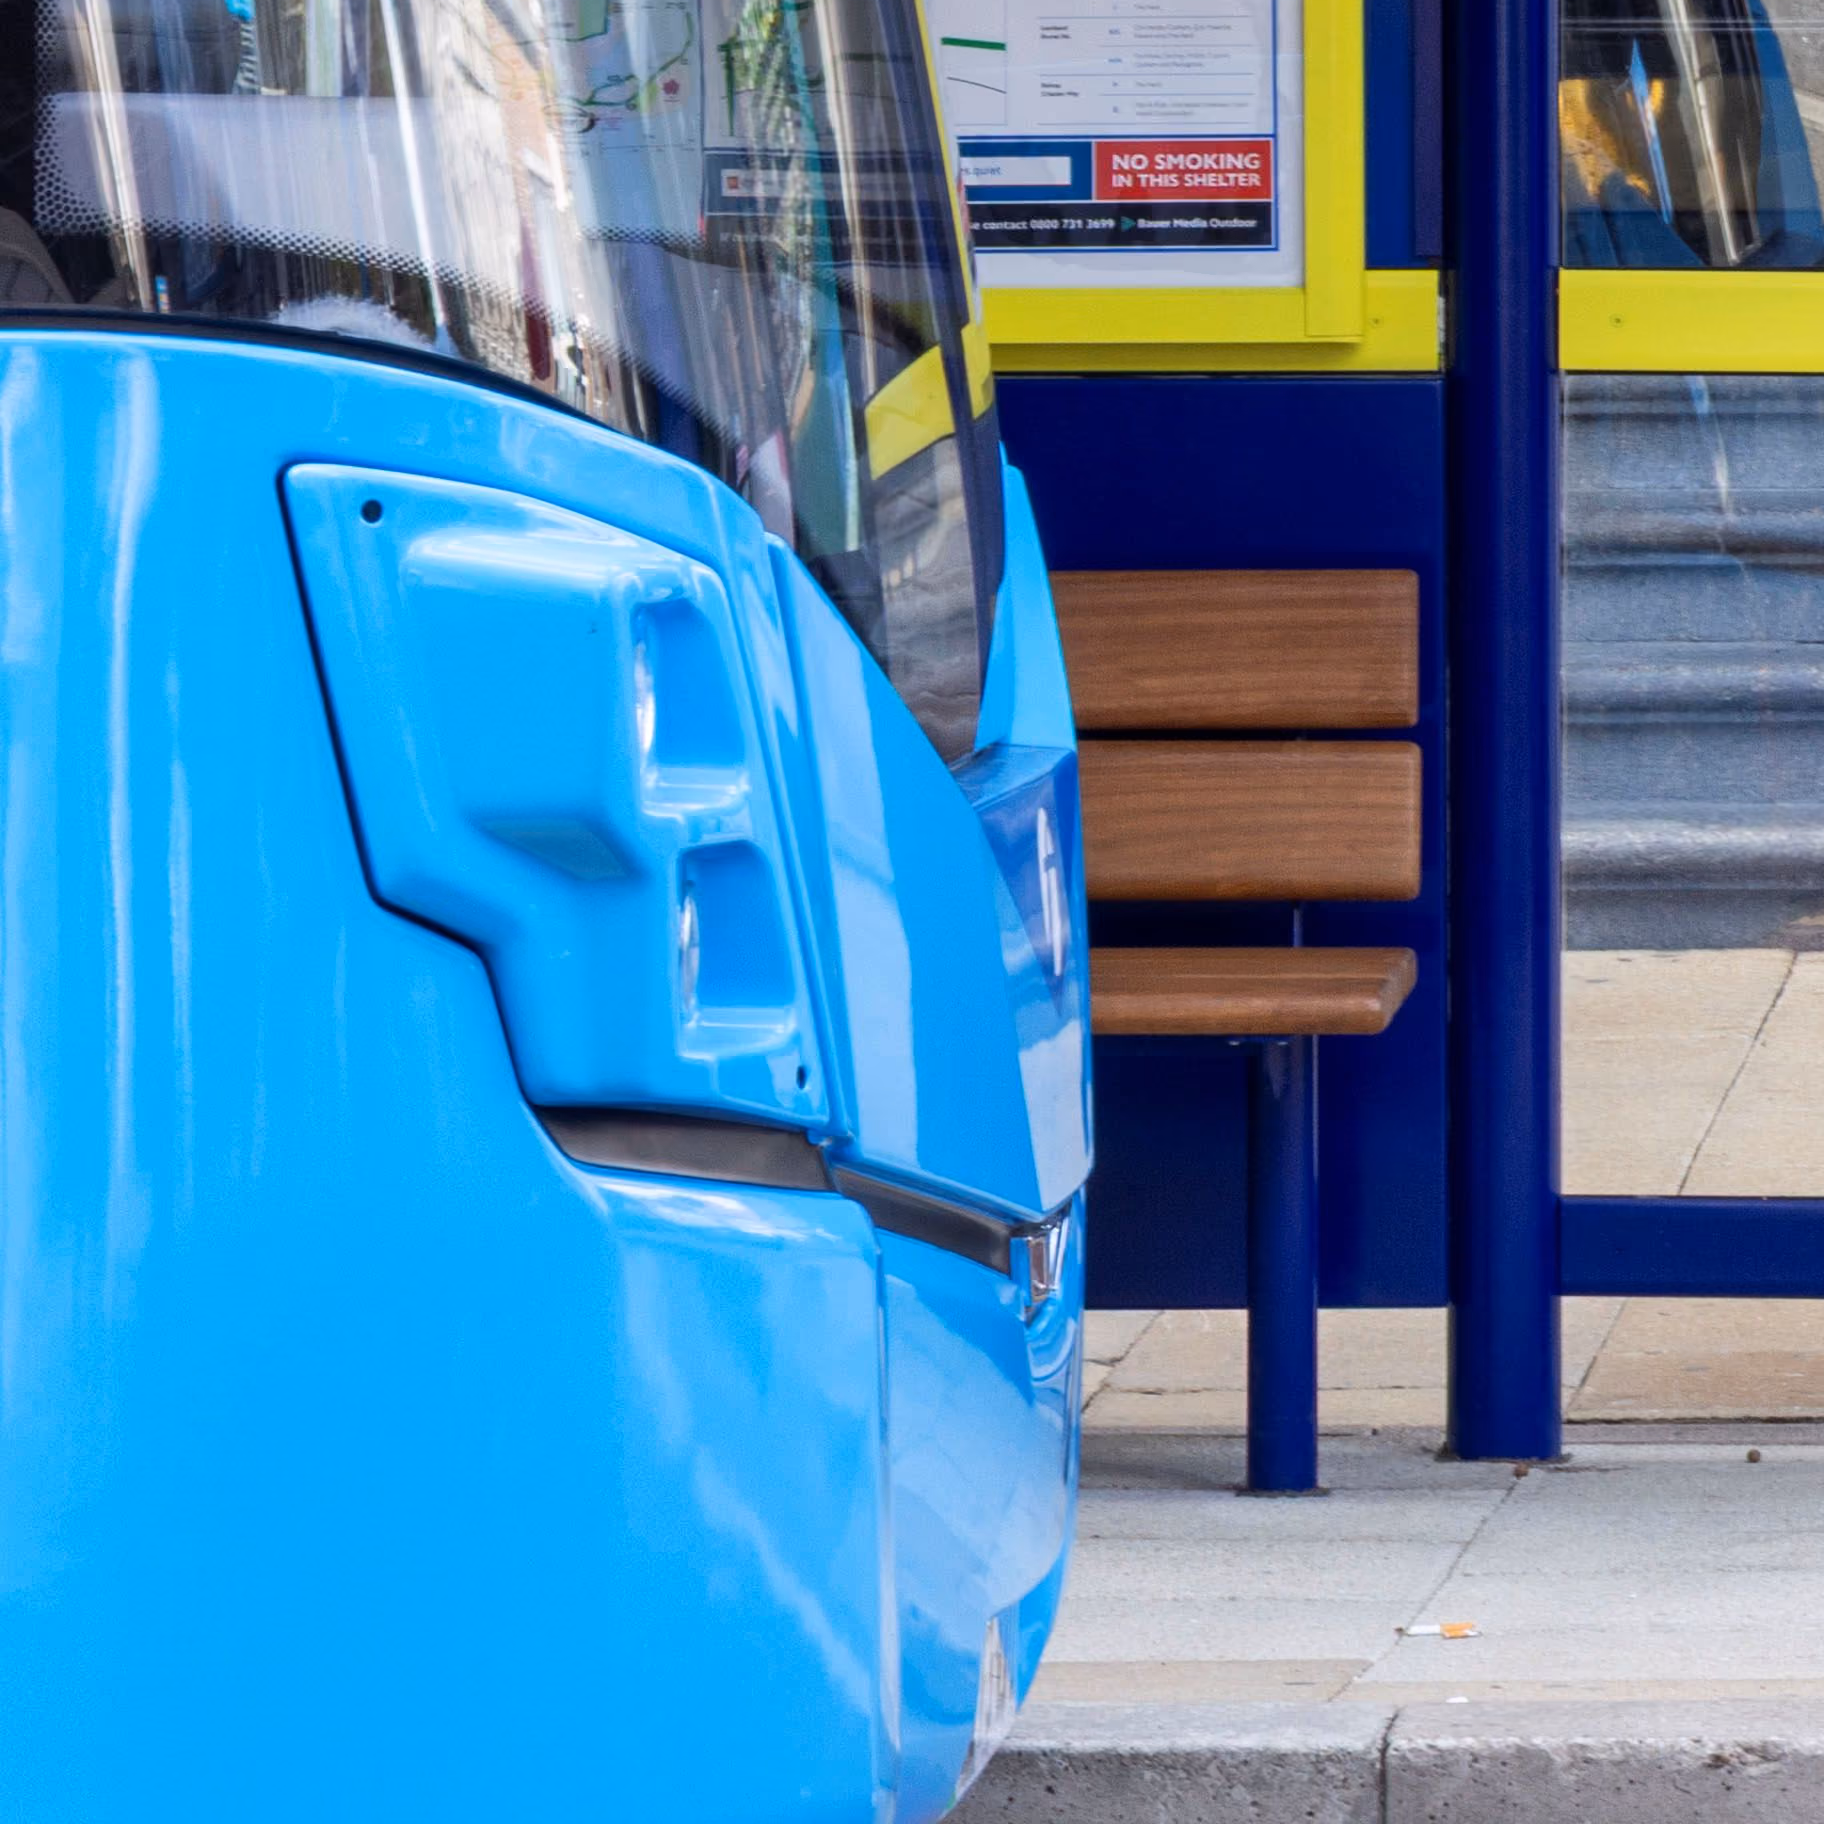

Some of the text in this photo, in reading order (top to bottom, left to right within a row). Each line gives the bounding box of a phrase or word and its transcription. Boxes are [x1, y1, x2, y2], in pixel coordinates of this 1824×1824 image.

[1112, 152, 1260, 171] NO SMOKING
[1112, 172, 1261, 188] IN THIS SHELTER
[983, 219, 1027, 230] contact
[1137, 217, 1257, 229] Bauer Media Outdoor
